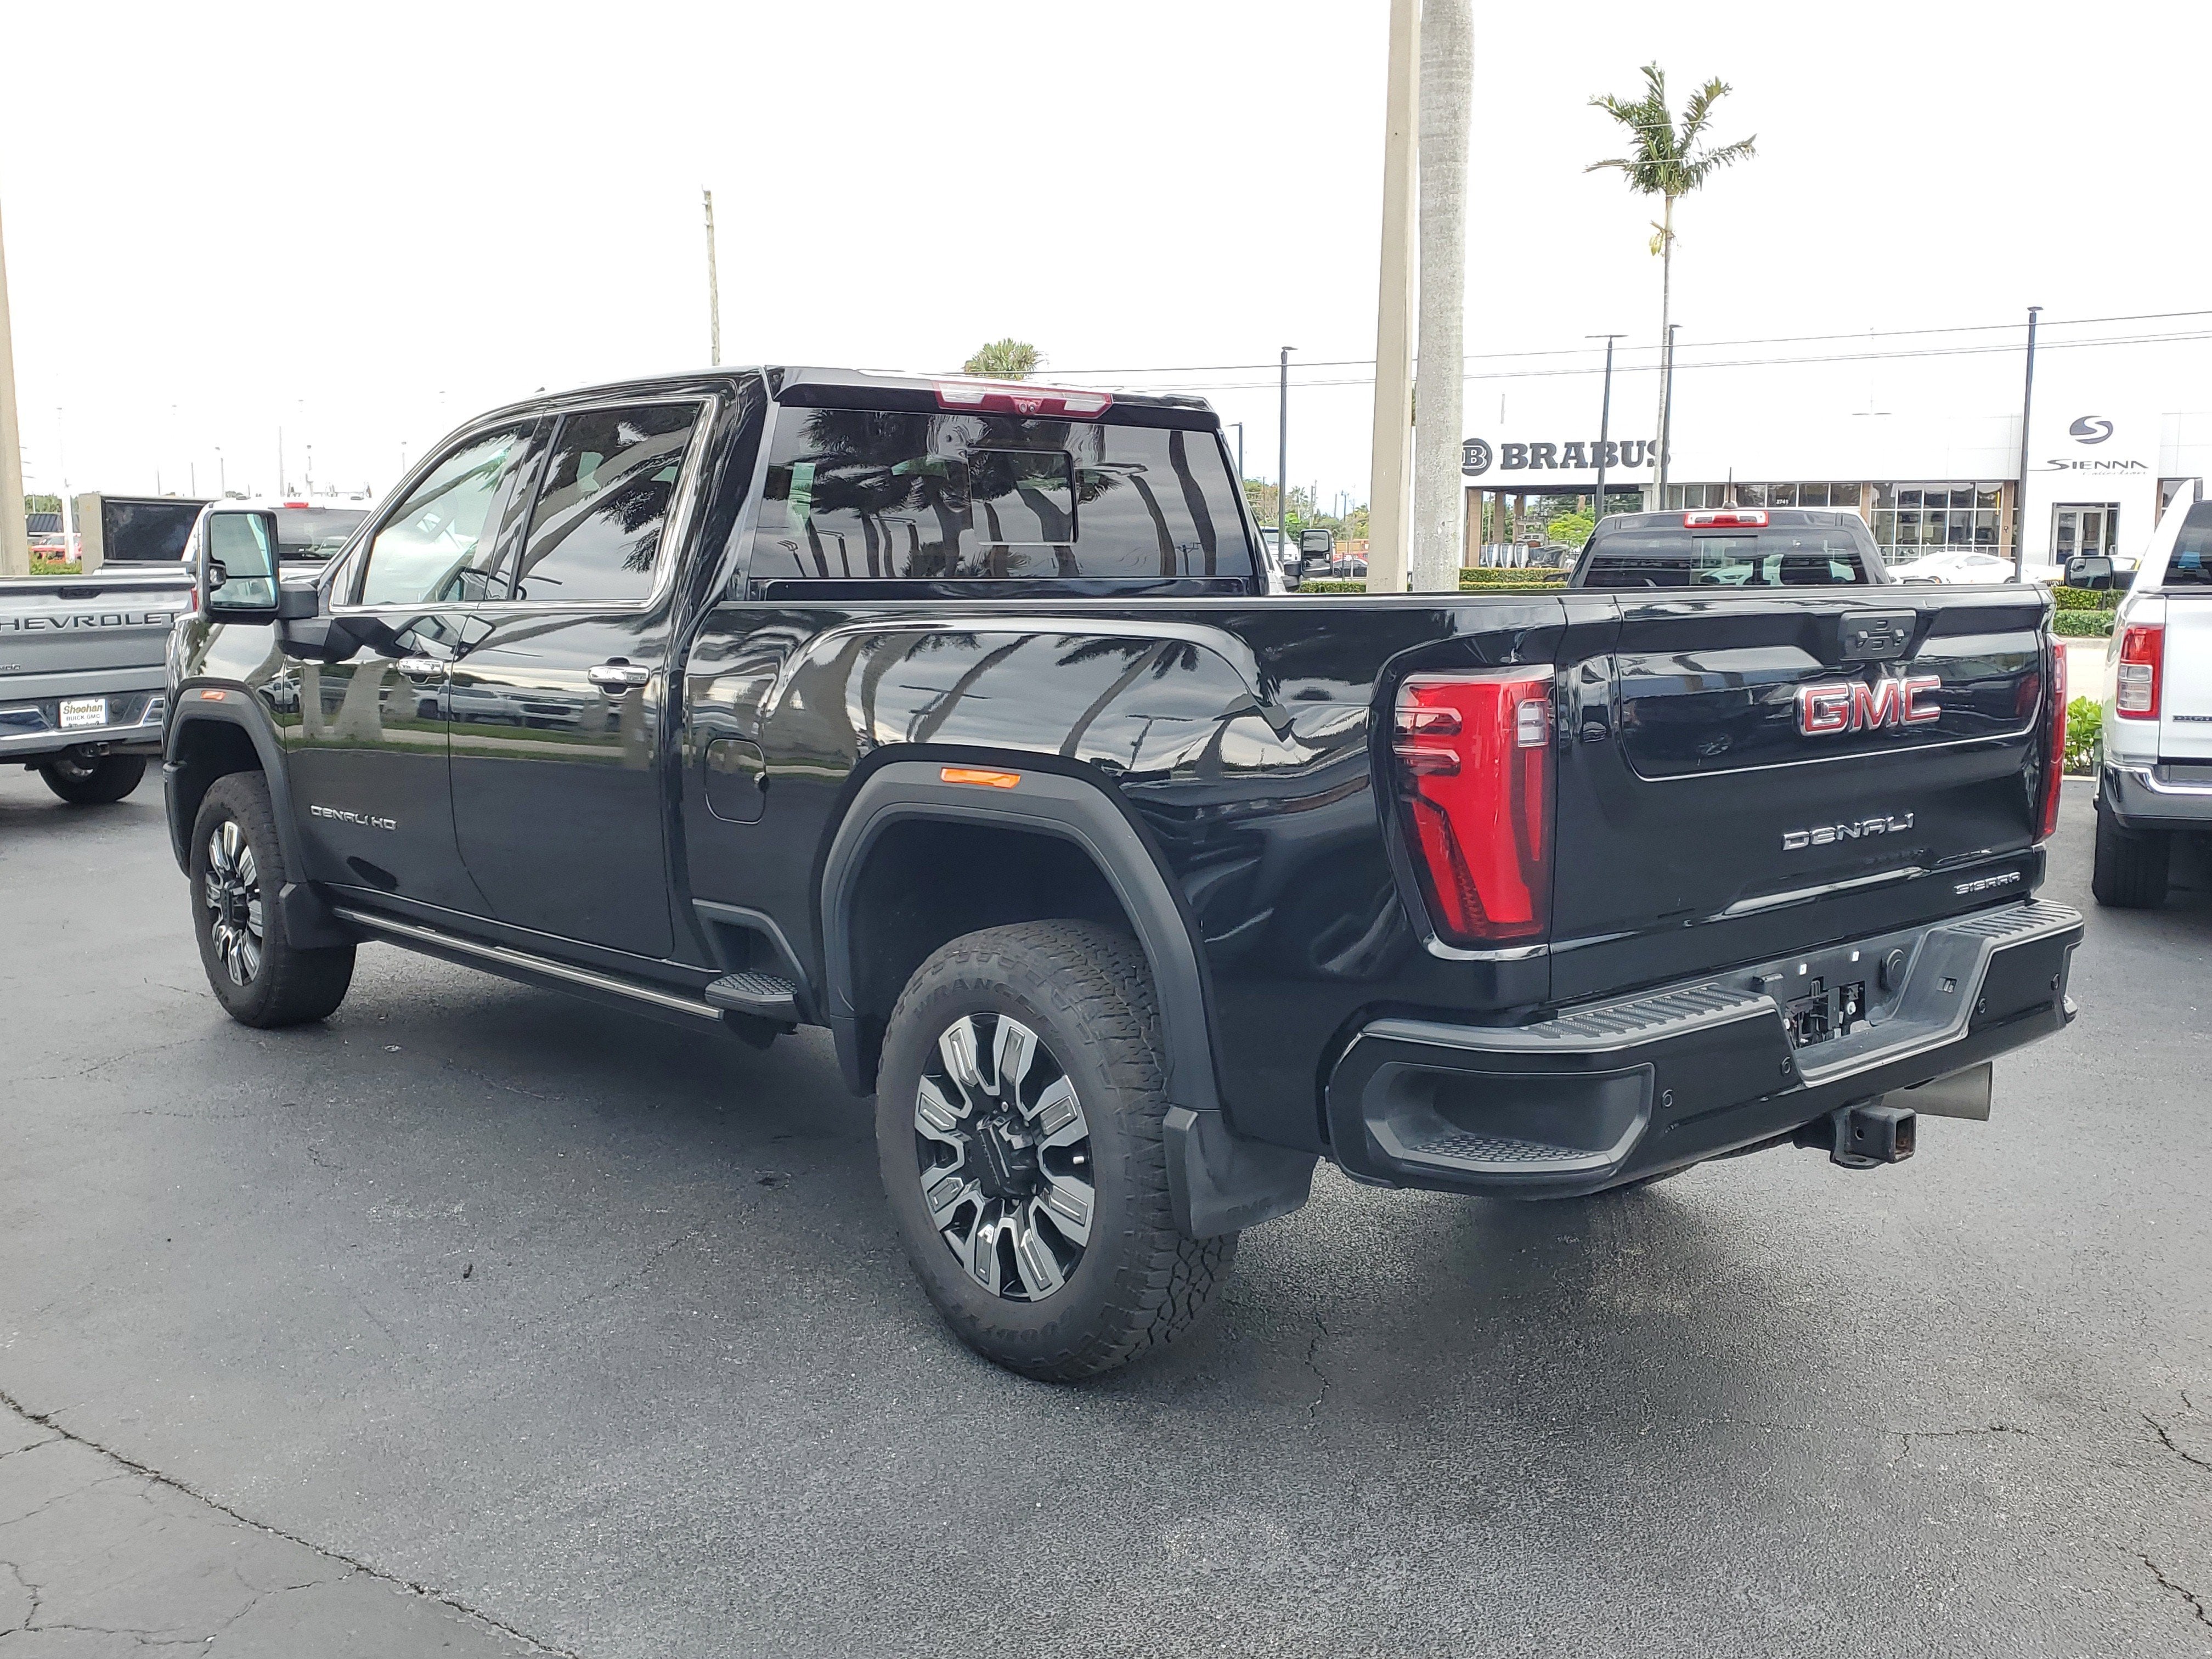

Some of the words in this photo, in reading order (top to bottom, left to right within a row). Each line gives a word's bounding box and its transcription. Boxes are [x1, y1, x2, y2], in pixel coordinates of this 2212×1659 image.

[2028, 459, 2149, 471] SIENNA
[1793, 675, 1941, 736] GMC
[311, 805, 369, 826] DENALI
[371, 816, 397, 831] HD
[1781, 812, 1915, 850] DENALI
[1954, 871, 2021, 895] SIERRA
